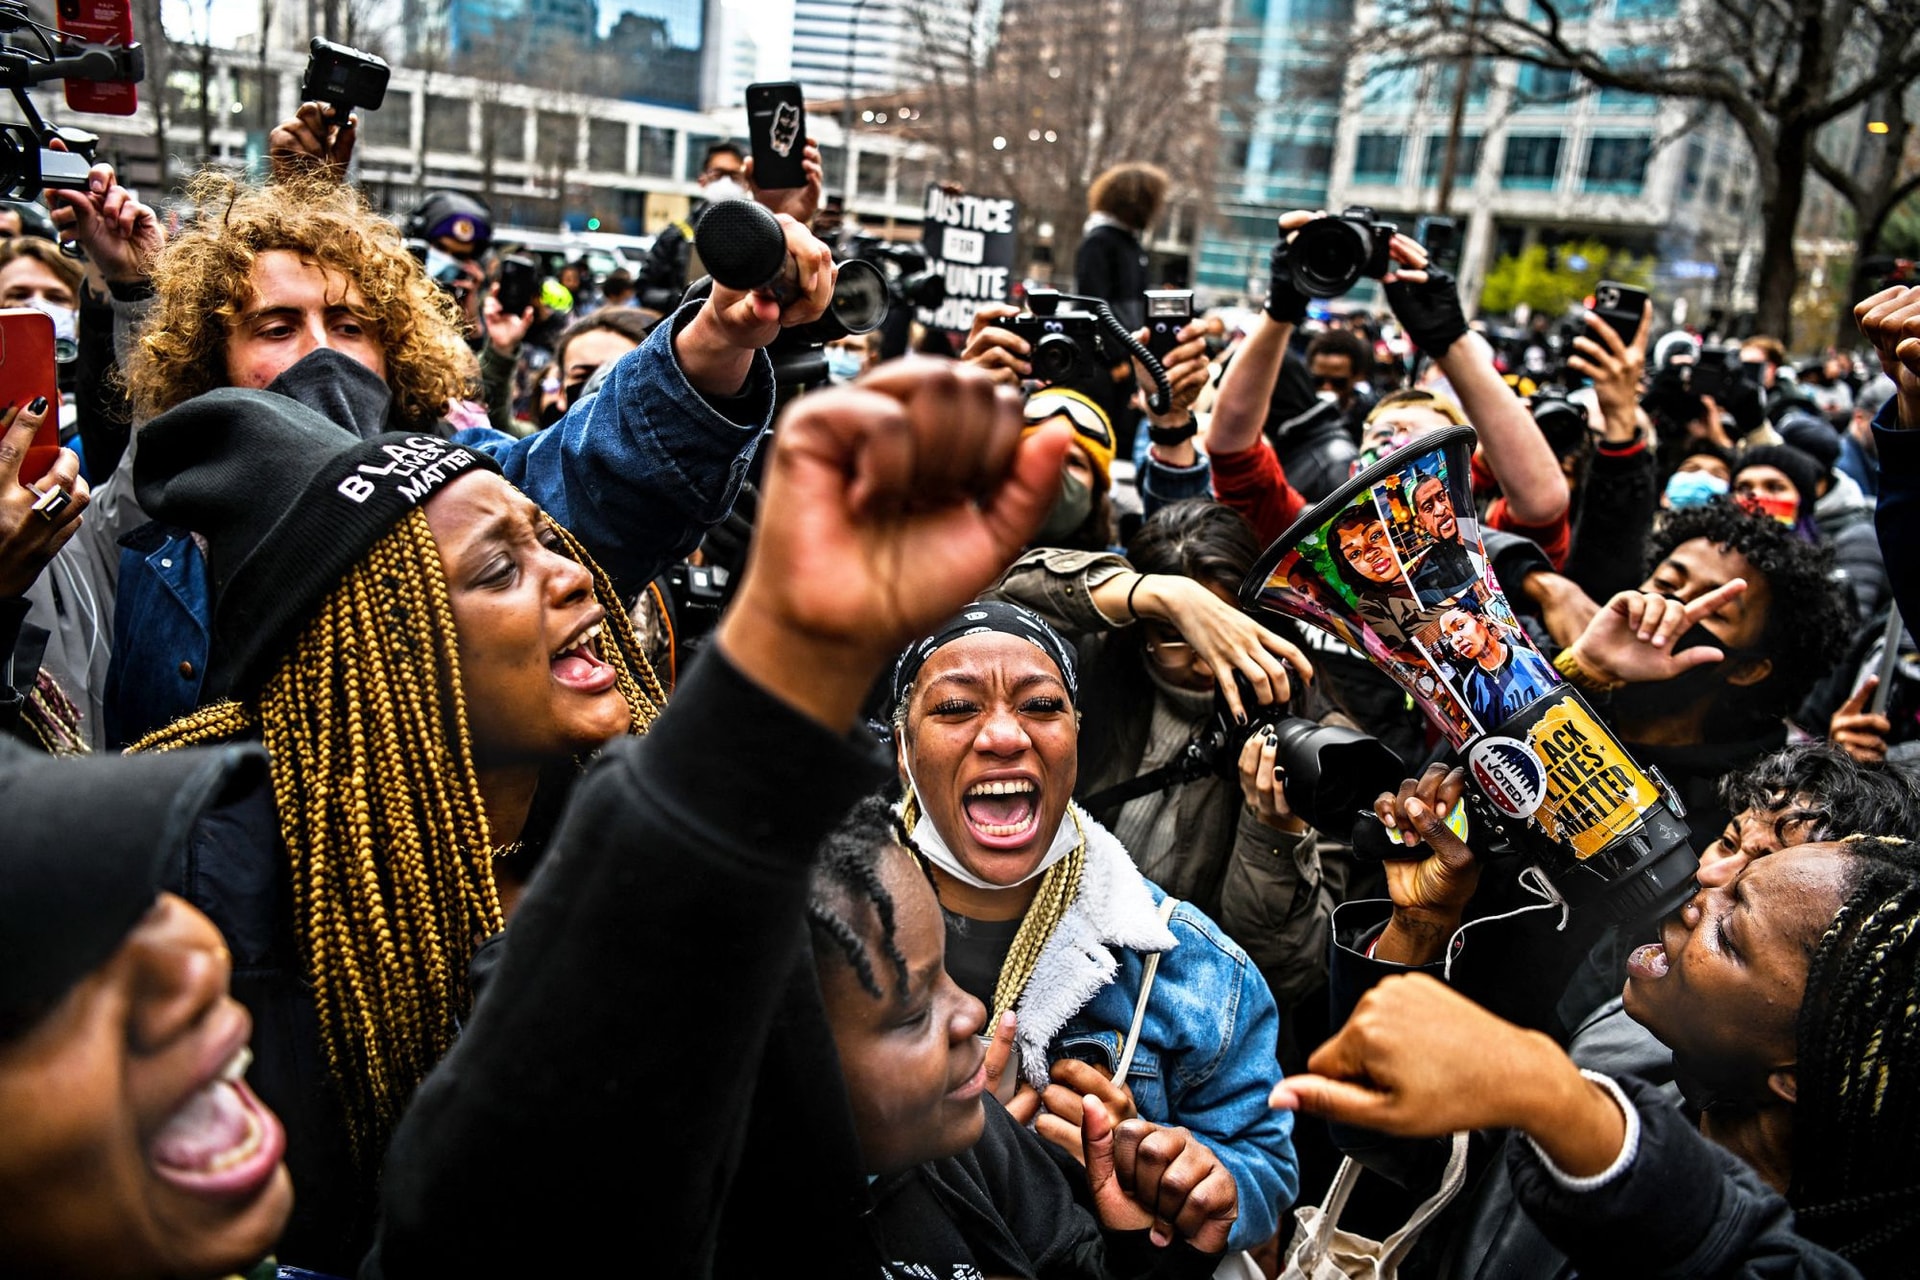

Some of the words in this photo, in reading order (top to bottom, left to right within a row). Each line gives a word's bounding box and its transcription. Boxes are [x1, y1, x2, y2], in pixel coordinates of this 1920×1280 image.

[927, 187, 1014, 233] JUSTICE
[397, 448, 477, 504] MATTER
[1537, 719, 1588, 771] ACK
[1487, 762, 1527, 807] VOTED!
[1545, 744, 1605, 803] LIVES
[1555, 764, 1635, 838] MATTER
